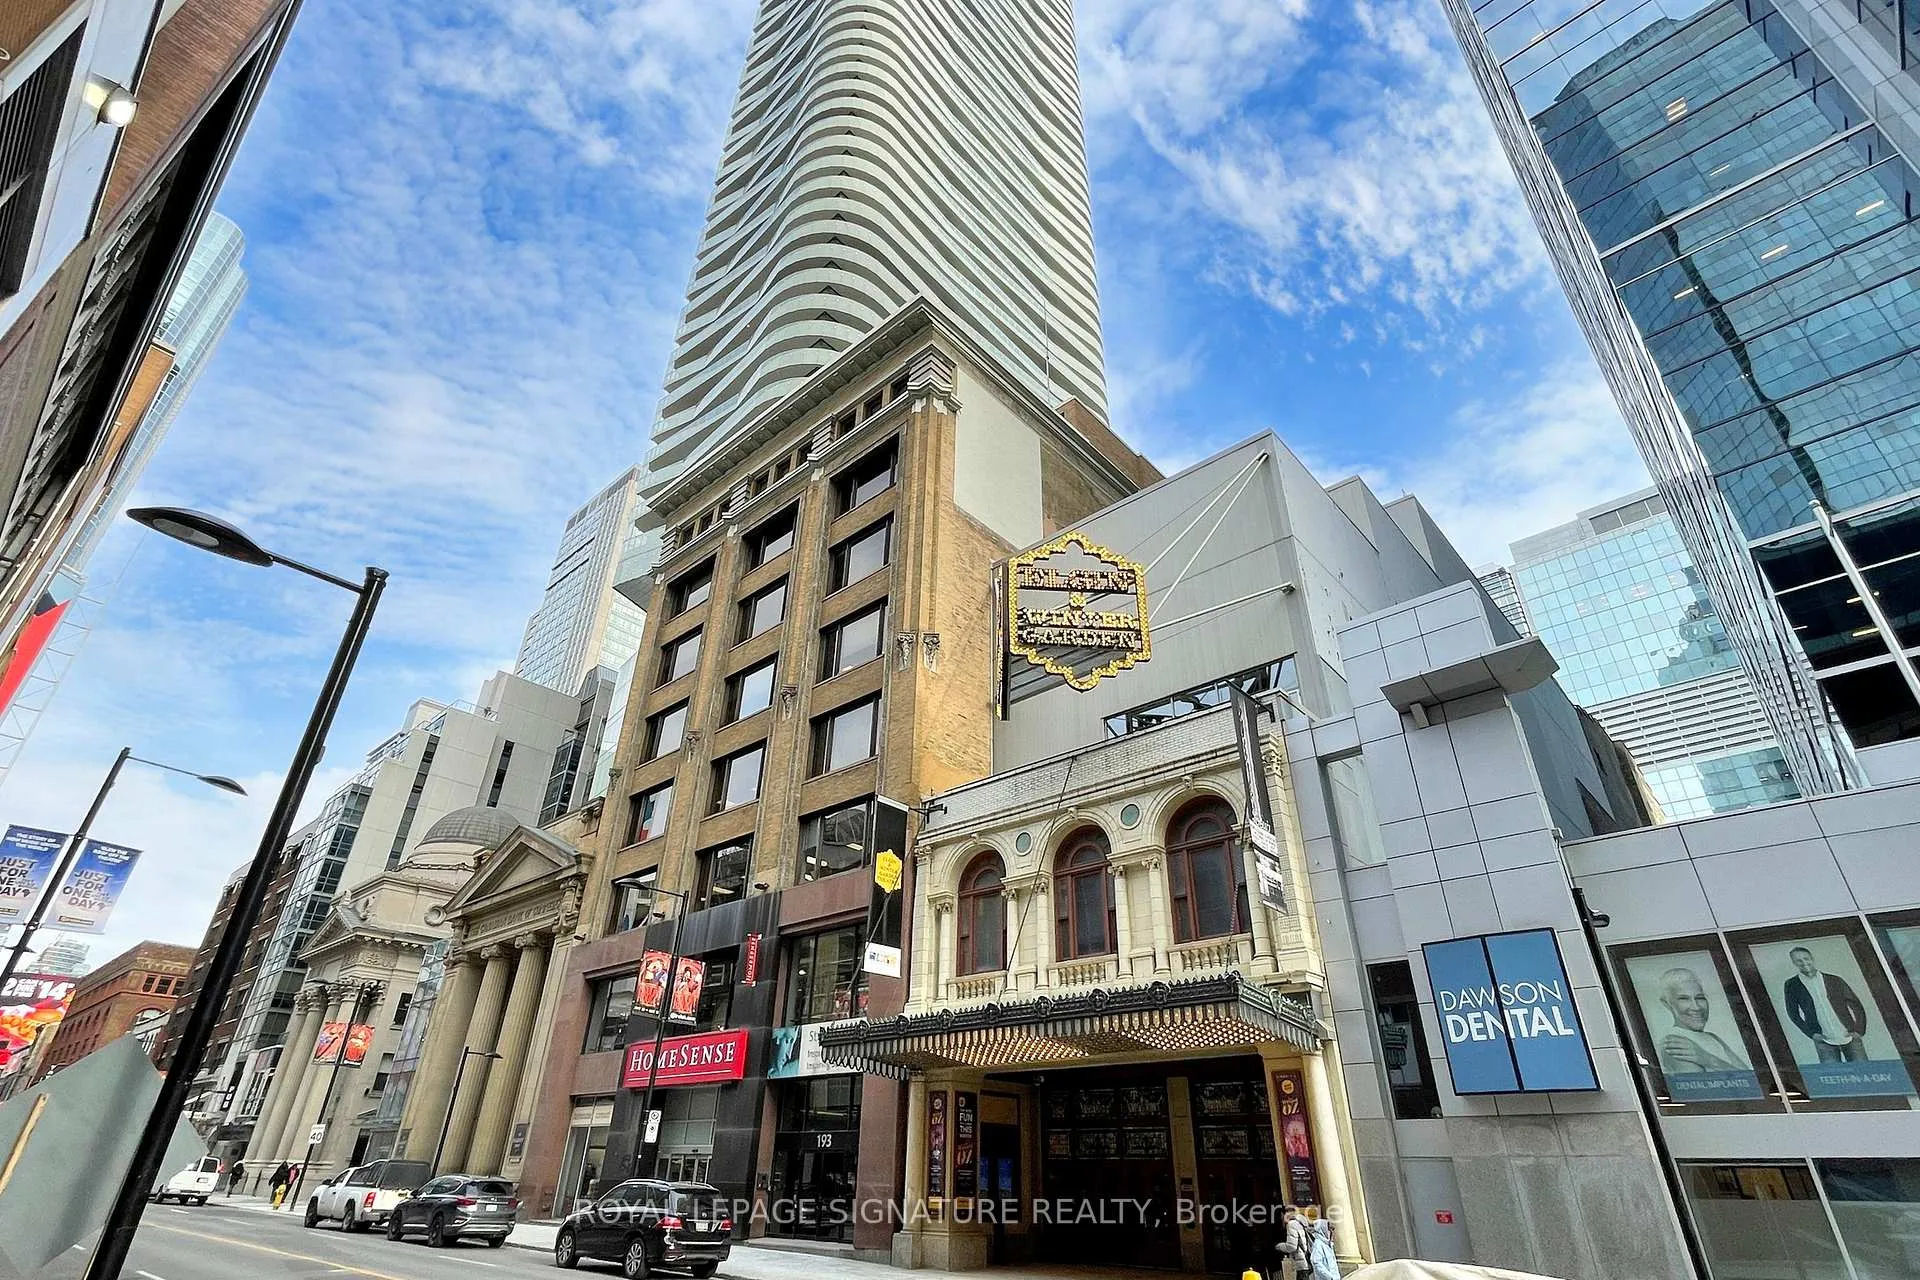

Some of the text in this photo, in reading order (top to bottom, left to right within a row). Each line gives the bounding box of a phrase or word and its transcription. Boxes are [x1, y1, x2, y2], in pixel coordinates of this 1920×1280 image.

[1022, 568, 1129, 591] ELGIN
[1022, 608, 1139, 630] WINTER
[1020, 627, 1138, 648] GARDEN
[0, 856, 38, 869] JUST
[0, 866, 28, 878] FOR
[74, 869, 111, 883] JUST
[0, 875, 16, 886] NE
[76, 879, 104, 891] FOR
[62, 886, 91, 899] ONE
[1, 978, 18, 996] 2
[1440, 980, 1563, 1011] DAWSON
[1445, 1005, 1575, 1043] DENTAL
[630, 1042, 736, 1072] HOMESENSE
[310, 1132, 323, 1142] 40
[816, 1133, 832, 1148] 193
